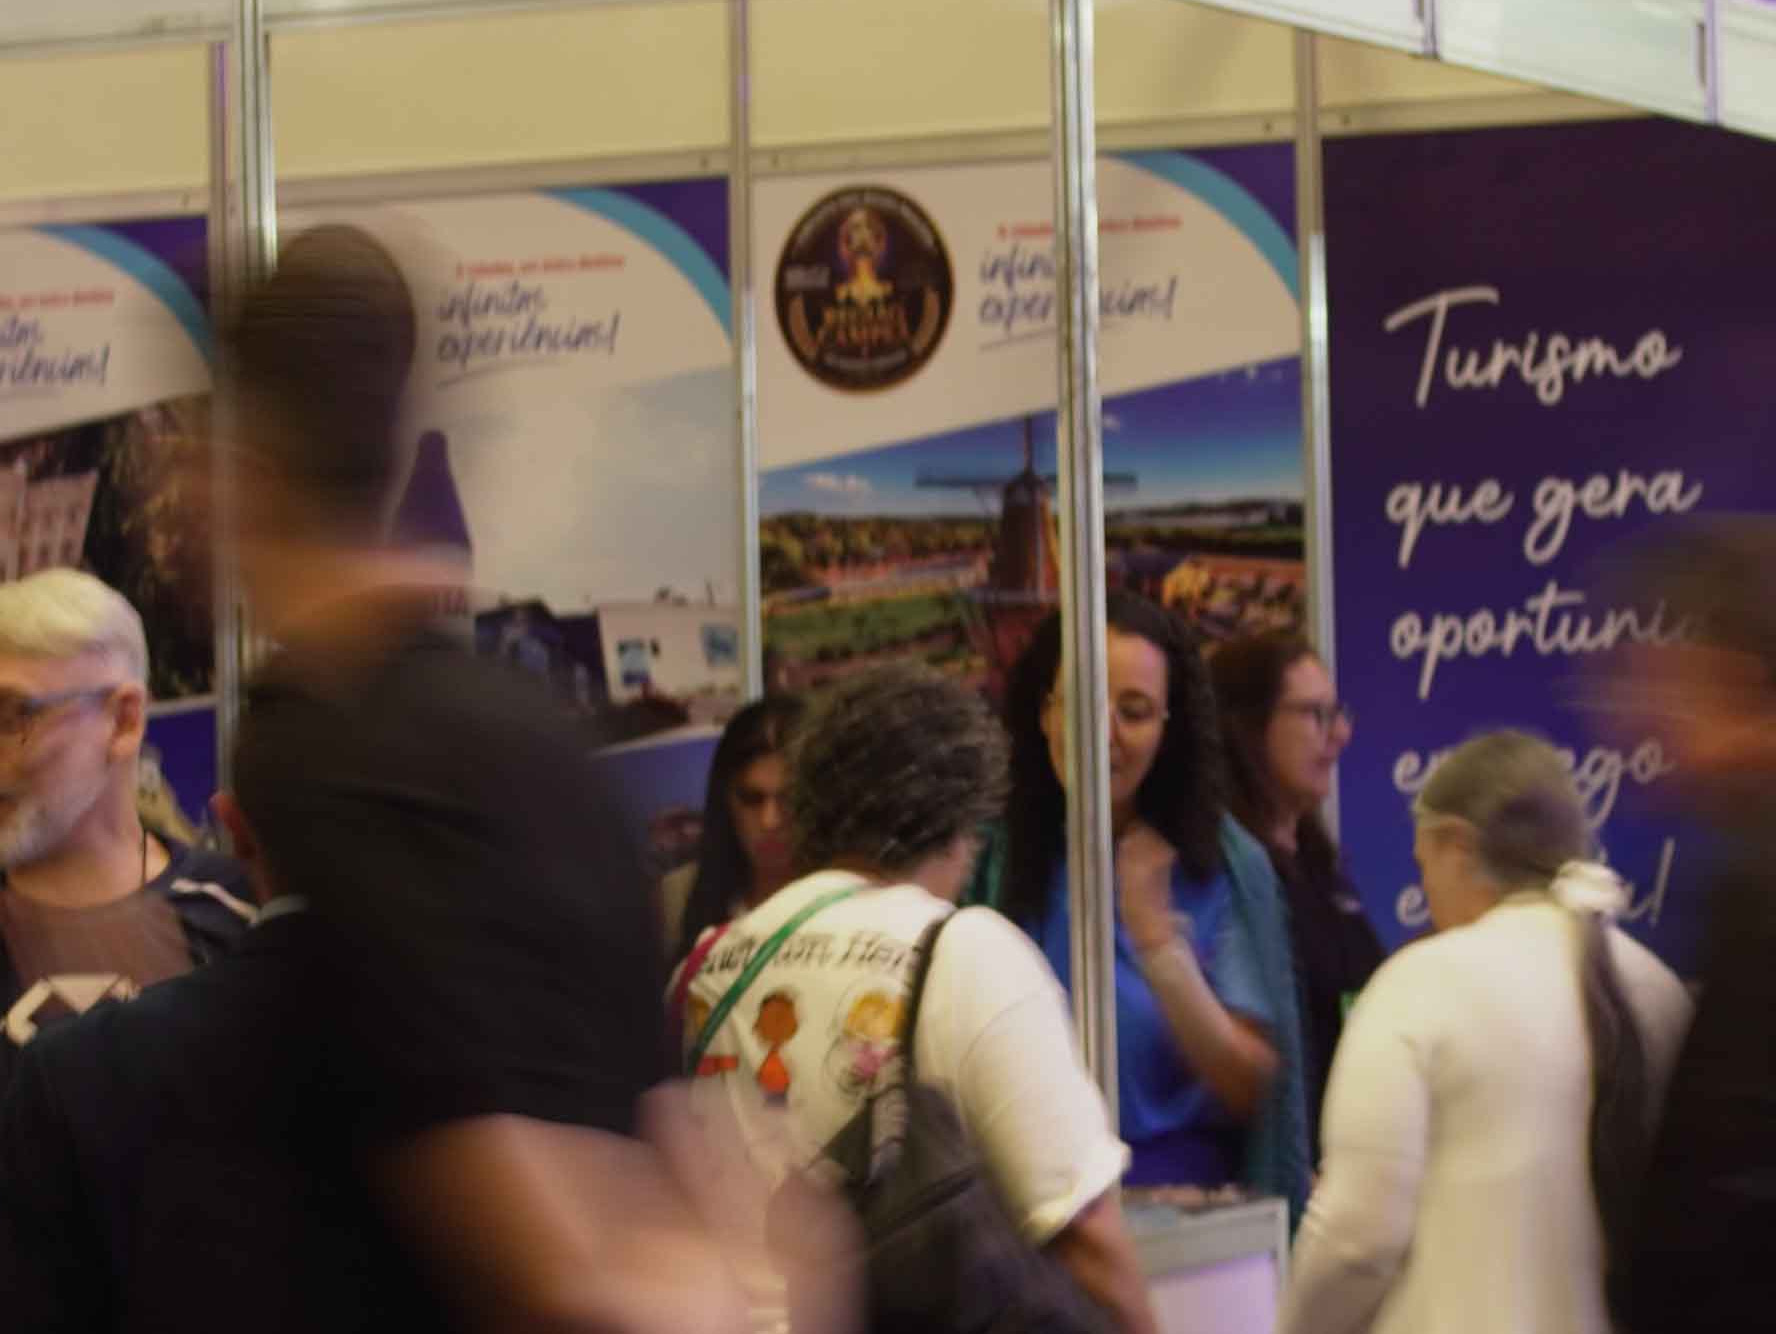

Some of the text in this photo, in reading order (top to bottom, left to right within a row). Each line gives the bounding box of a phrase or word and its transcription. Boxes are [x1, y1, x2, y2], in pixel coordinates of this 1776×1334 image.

[1384, 286, 1682, 409] Turismo
[1385, 464, 1703, 570] que gera
